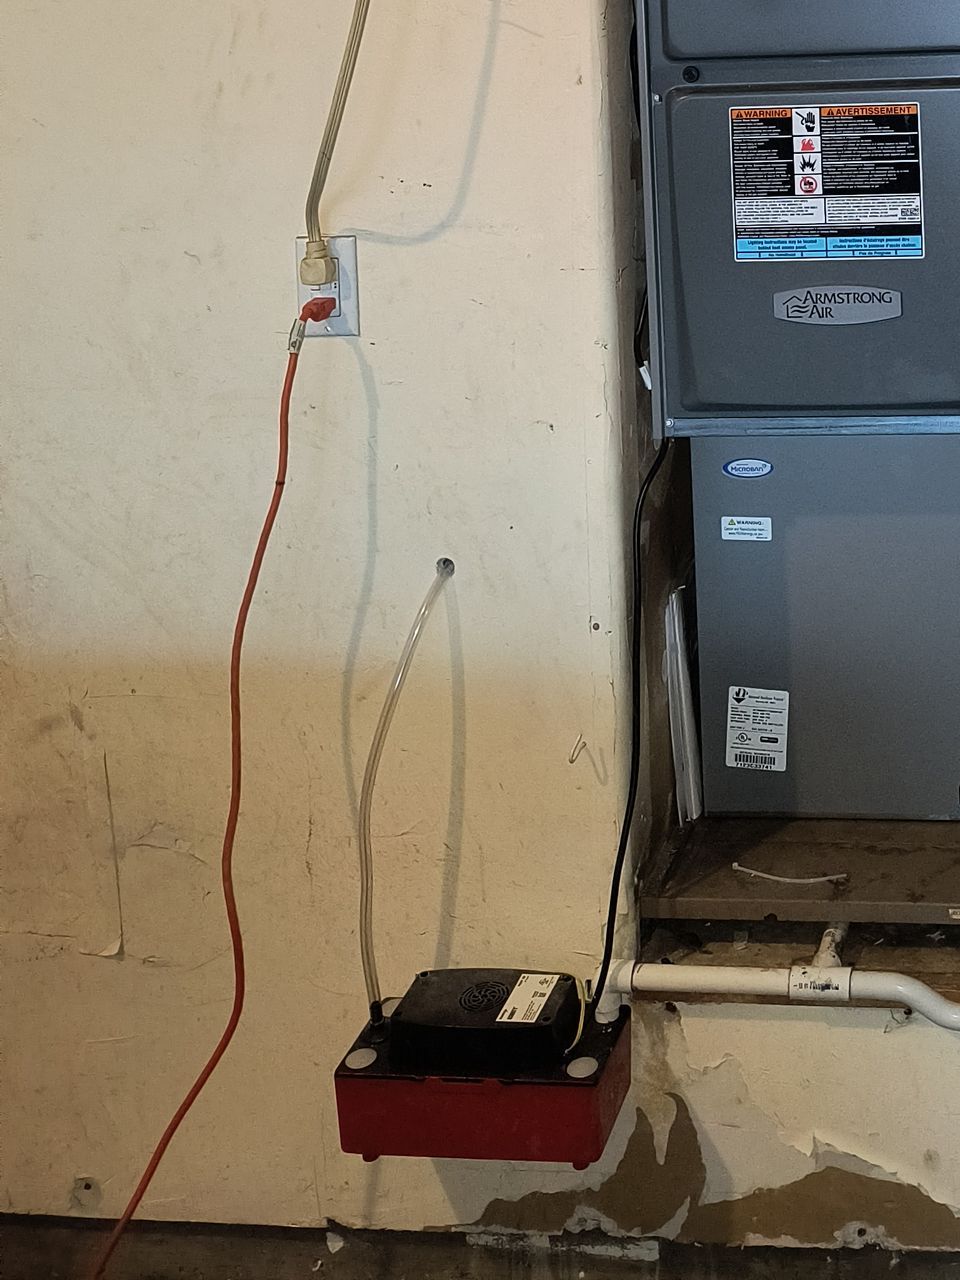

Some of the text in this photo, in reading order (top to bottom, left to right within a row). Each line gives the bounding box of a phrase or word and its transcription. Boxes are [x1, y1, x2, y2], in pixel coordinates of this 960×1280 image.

[743, 106, 912, 118] WARNING AVERTISSEMENT
[802, 290, 893, 319] ARMSTRONG AIR
